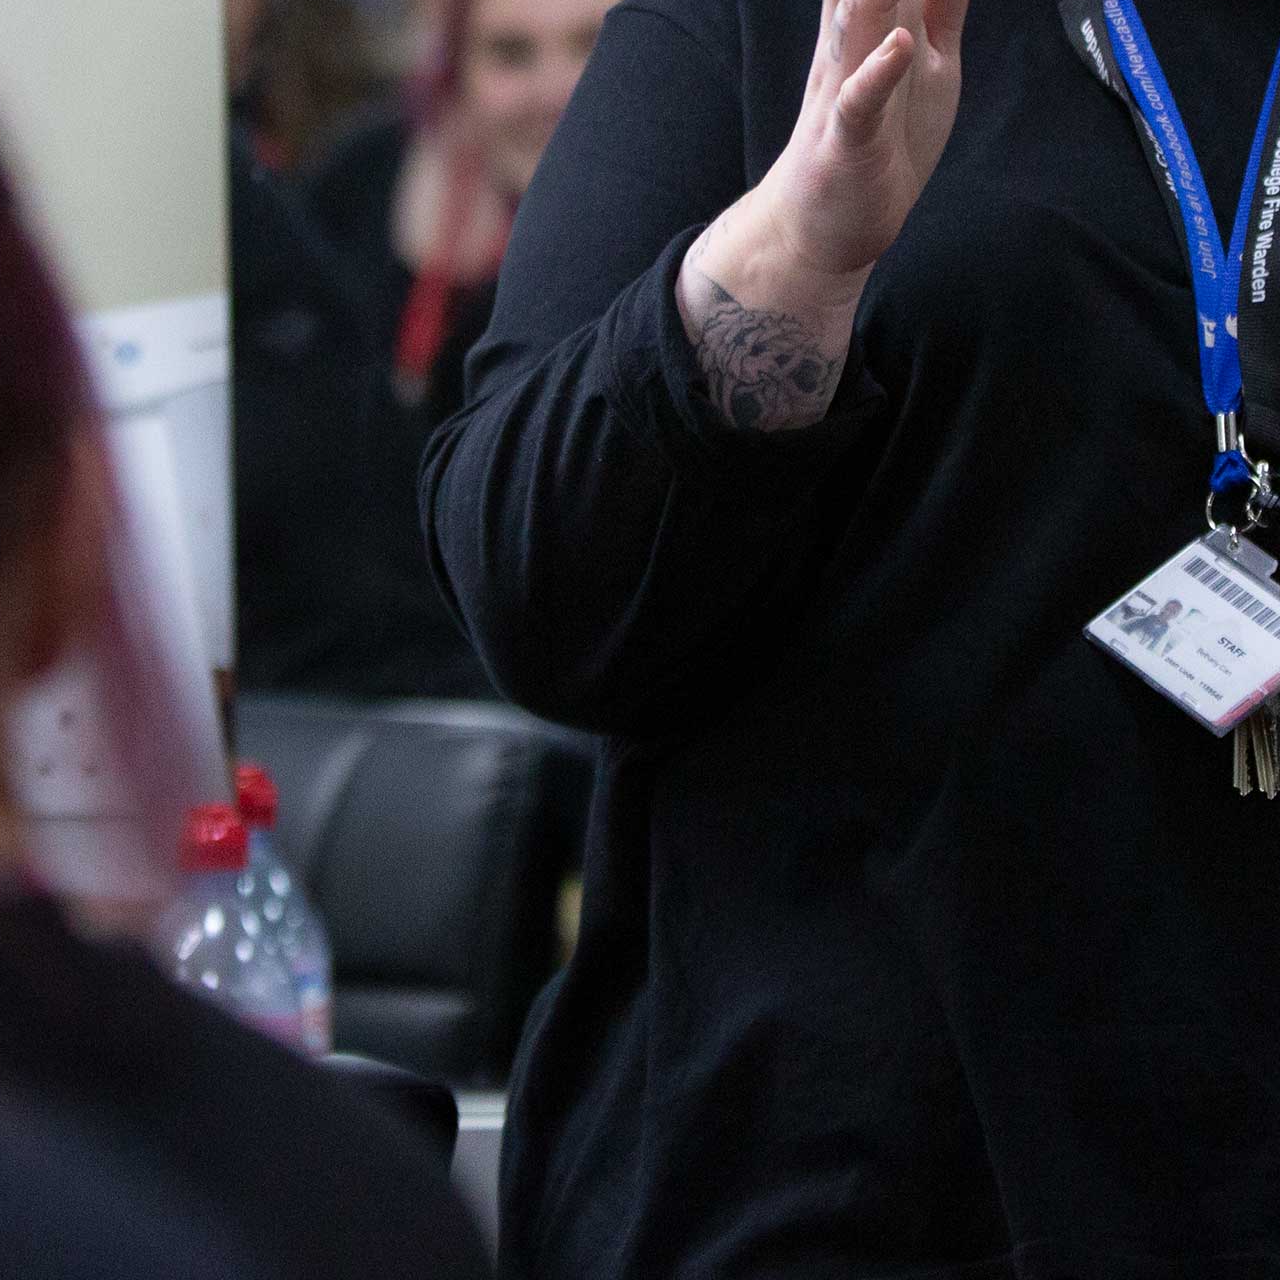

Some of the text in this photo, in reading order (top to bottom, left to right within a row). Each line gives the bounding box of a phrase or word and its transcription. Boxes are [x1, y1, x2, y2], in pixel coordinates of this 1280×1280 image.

[1186, 192, 1203, 212] at
[1194, 214, 1210, 235] us
[1198, 238, 1217, 280] Join
[1250, 231, 1275, 304] Warden
[1216, 635, 1248, 659] STAFF
